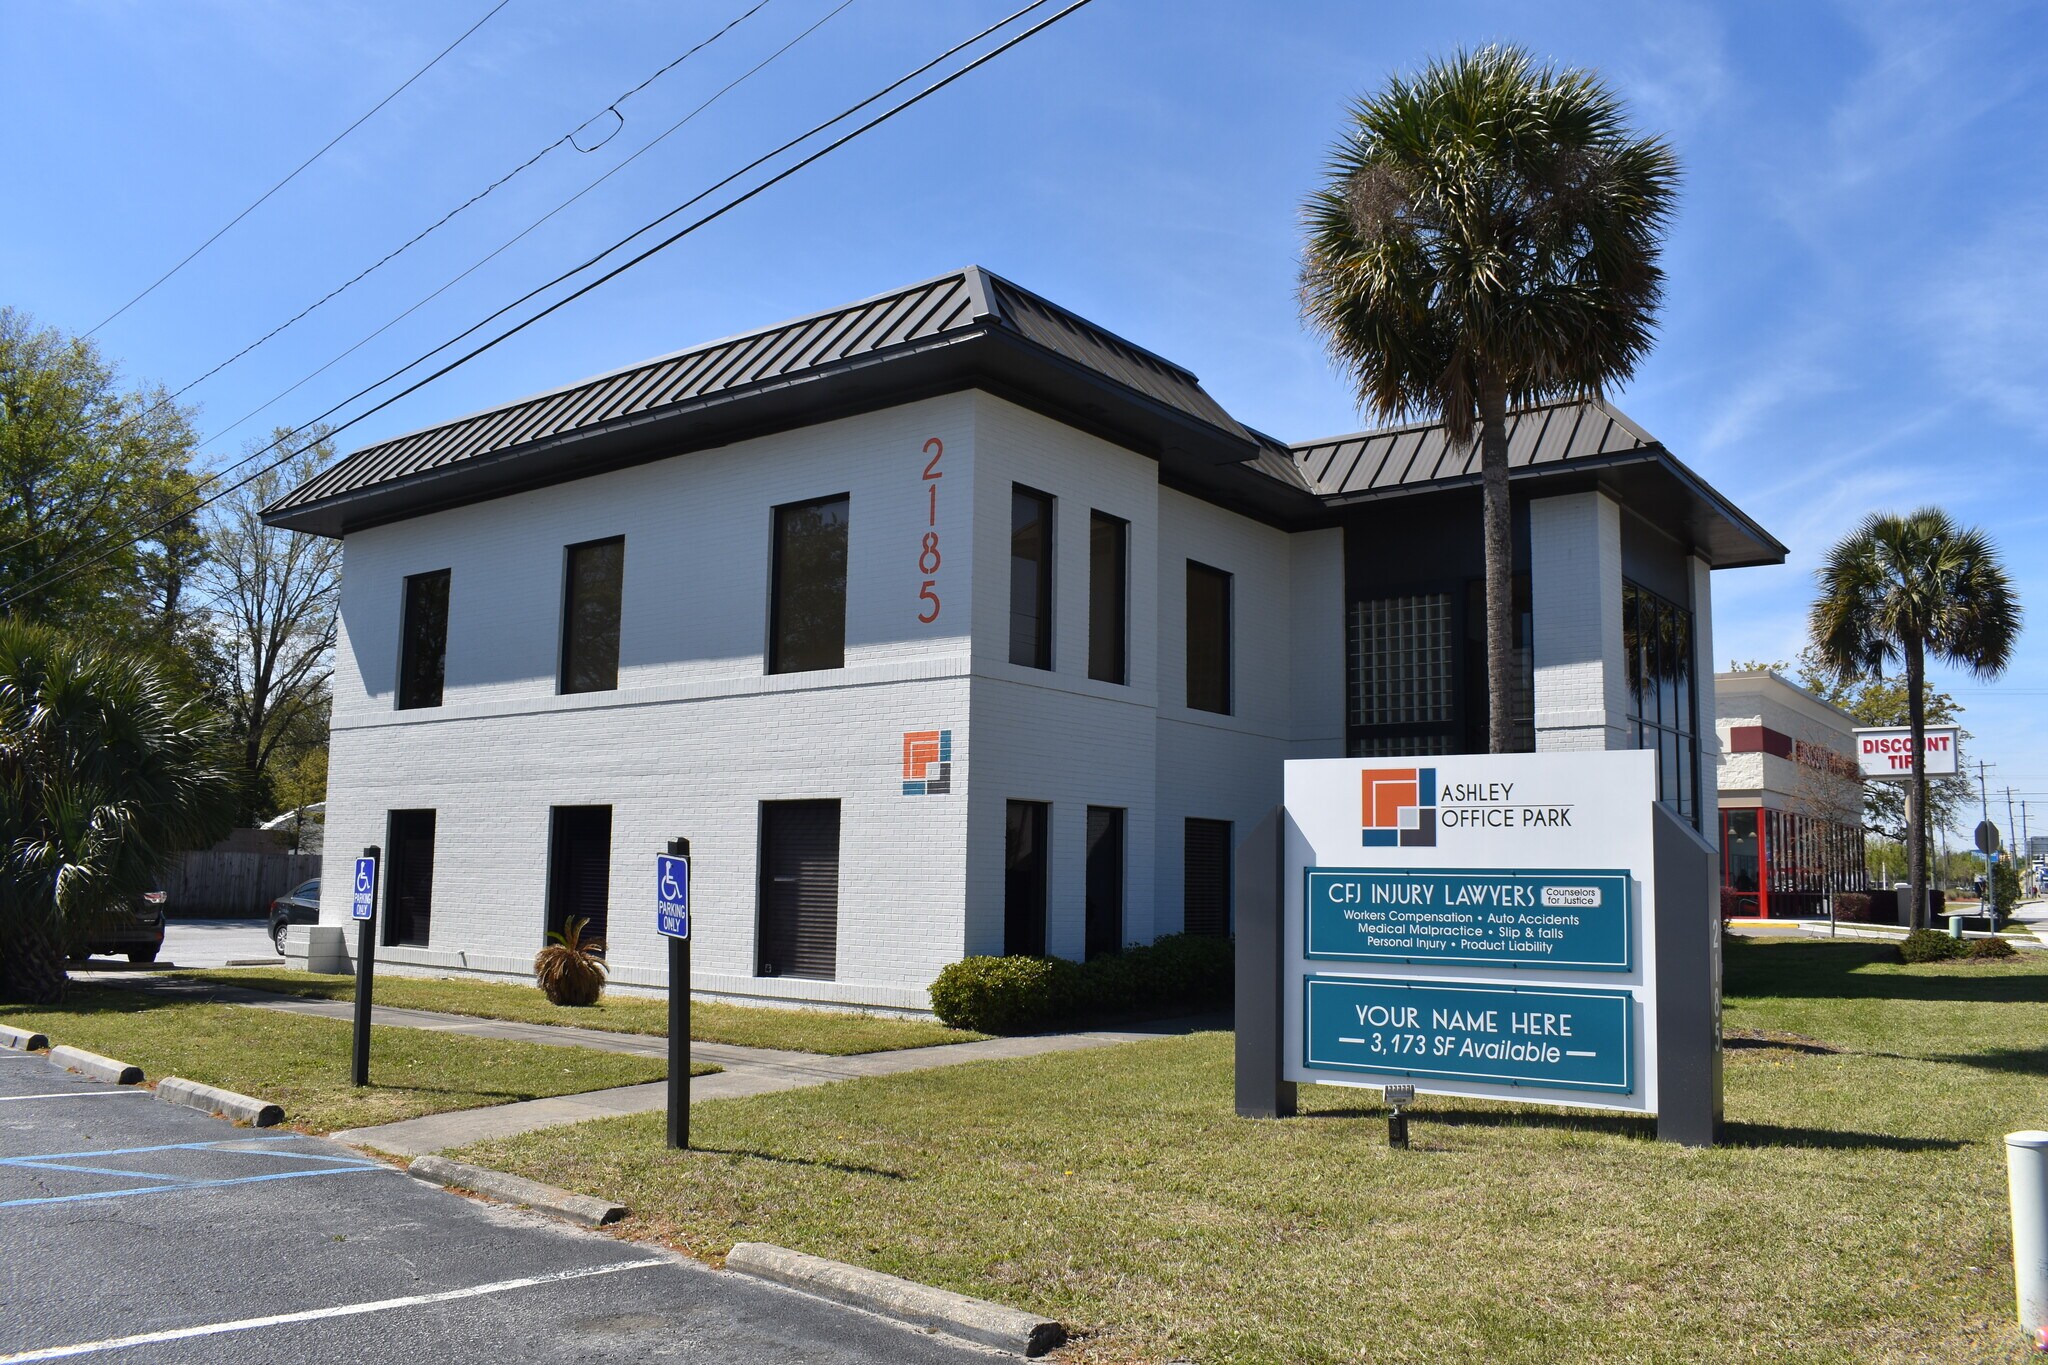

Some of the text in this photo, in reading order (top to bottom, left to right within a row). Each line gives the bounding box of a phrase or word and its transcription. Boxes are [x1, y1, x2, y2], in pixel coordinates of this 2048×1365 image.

[917, 436, 944, 624] 2185
[1863, 737, 1949, 753] DISCONT
[1441, 783, 1514, 802] ASHLEY
[1441, 808, 1572, 828] OFFICE PARK
[354, 892, 371, 904] PARKING
[1328, 883, 1536, 907] CFJ INJURY LAWYERS
[1546, 888, 1595, 897] Counselors
[1548, 897, 1594, 905] for Justice
[659, 900, 685, 919] PARKING
[1343, 909, 1580, 926] Workers Compensation Auto Accidents
[663, 916, 680, 932] ONLY
[1358, 923, 1564, 940] Medical Malpractice Slip & falls
[1367, 936, 1553, 954] Personal Injury Product Liability
[1712, 919, 1721, 1052] 2185
[1356, 1005, 1572, 1037] YOUR NAME HERE
[1370, 1032, 1561, 1063] 3,173 SF Available
